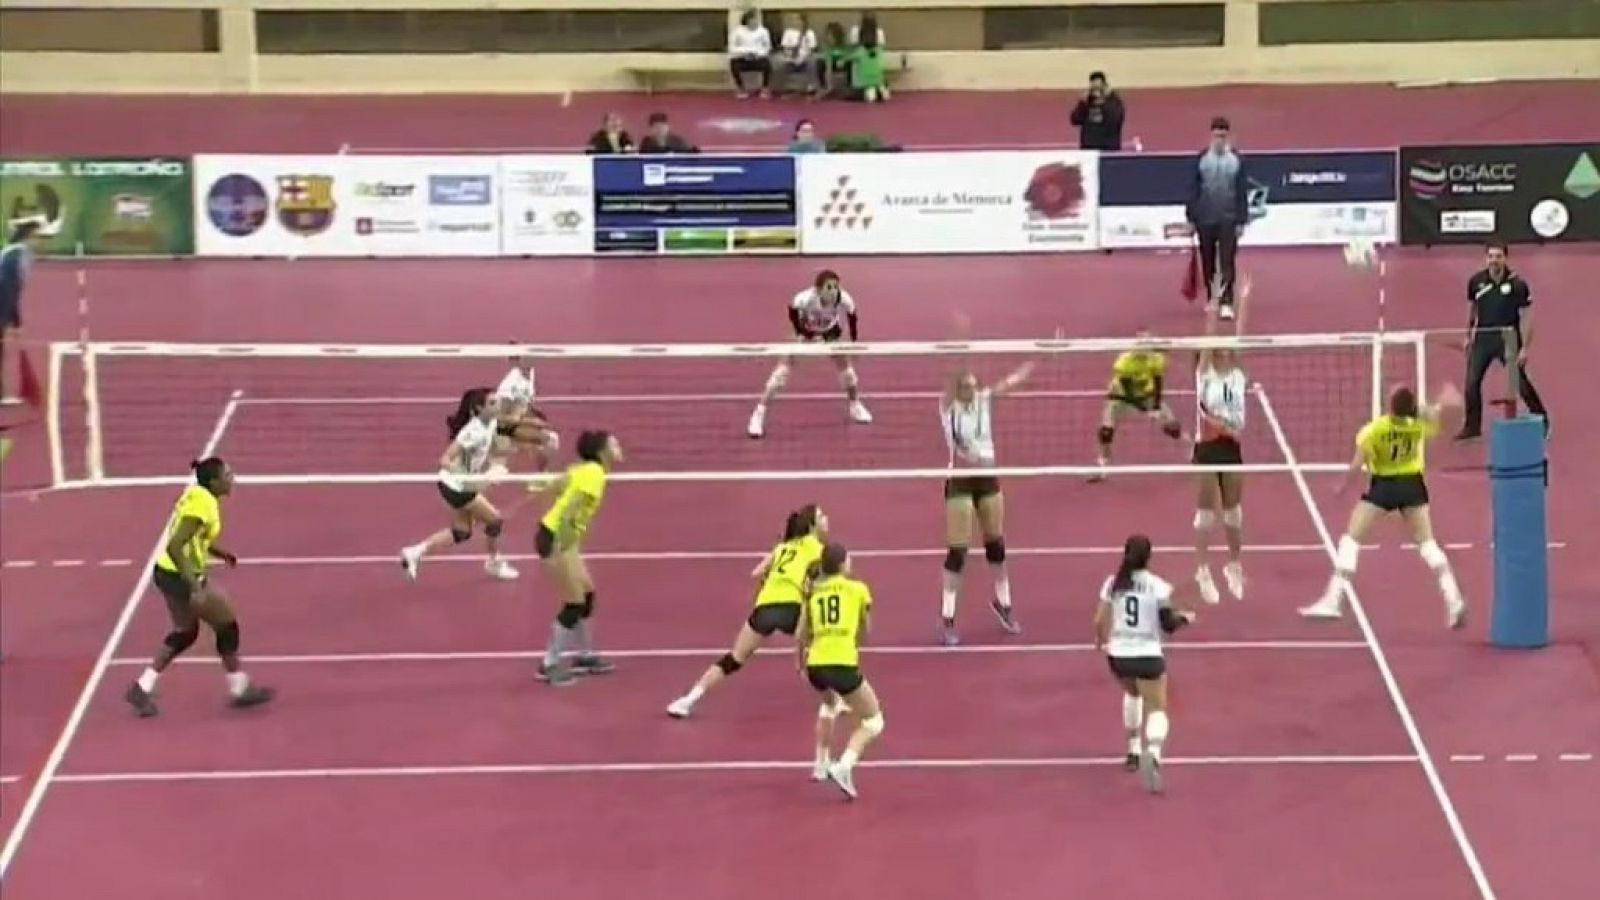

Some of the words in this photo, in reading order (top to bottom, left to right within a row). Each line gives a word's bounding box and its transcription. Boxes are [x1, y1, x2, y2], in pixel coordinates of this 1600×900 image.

[931, 191, 949, 205] de
[816, 595, 841, 626] 18
[1125, 595, 1140, 628] 9
